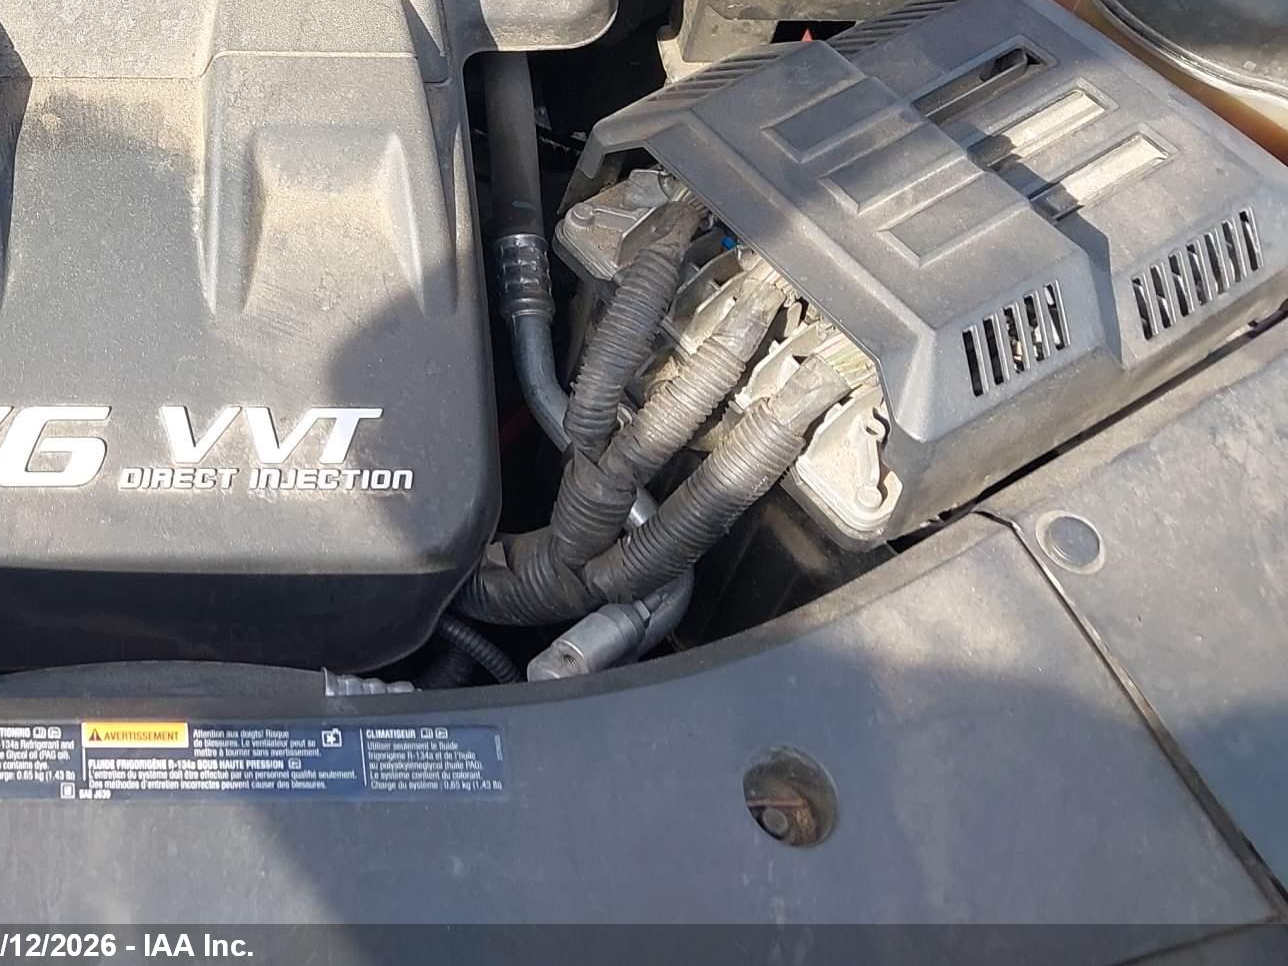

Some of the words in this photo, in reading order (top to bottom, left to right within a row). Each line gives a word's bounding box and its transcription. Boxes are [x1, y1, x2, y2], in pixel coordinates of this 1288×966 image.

[160, 405, 383, 464] VVT
[119, 467, 240, 490] DIRECT
[249, 467, 414, 490] INJECTION
[104, 731, 179, 741] AVERTISSEMENT
[193, 729, 224, 739] Attention
[226, 729, 238, 739] aux
[265, 729, 289, 739] Risque
[366, 729, 416, 738] CLIMATISEUR
[62, 740, 74, 750] and
[193, 739, 203, 748] de
[252, 739, 287, 748] ventilateur
[290, 739, 305, 748] peut
[194, 748, 217, 757] mettre
[225, 748, 250, 757] tourner
[252, 748, 269, 757] sans
[3, 761, 33, 770] contains
[220, 759, 244, 769] HAUTE
[246, 759, 283, 769] PRESSION
[127, 770, 136, 780] du
[230, 770, 242, 780] par
[255, 770, 289, 780] personnel
[89, 780, 102, 789] Des
[181, 780, 219, 789] incorrectes
[221, 780, 249, 789] peuvent
[251, 780, 275, 789] causer
[277, 780, 290, 789] des
